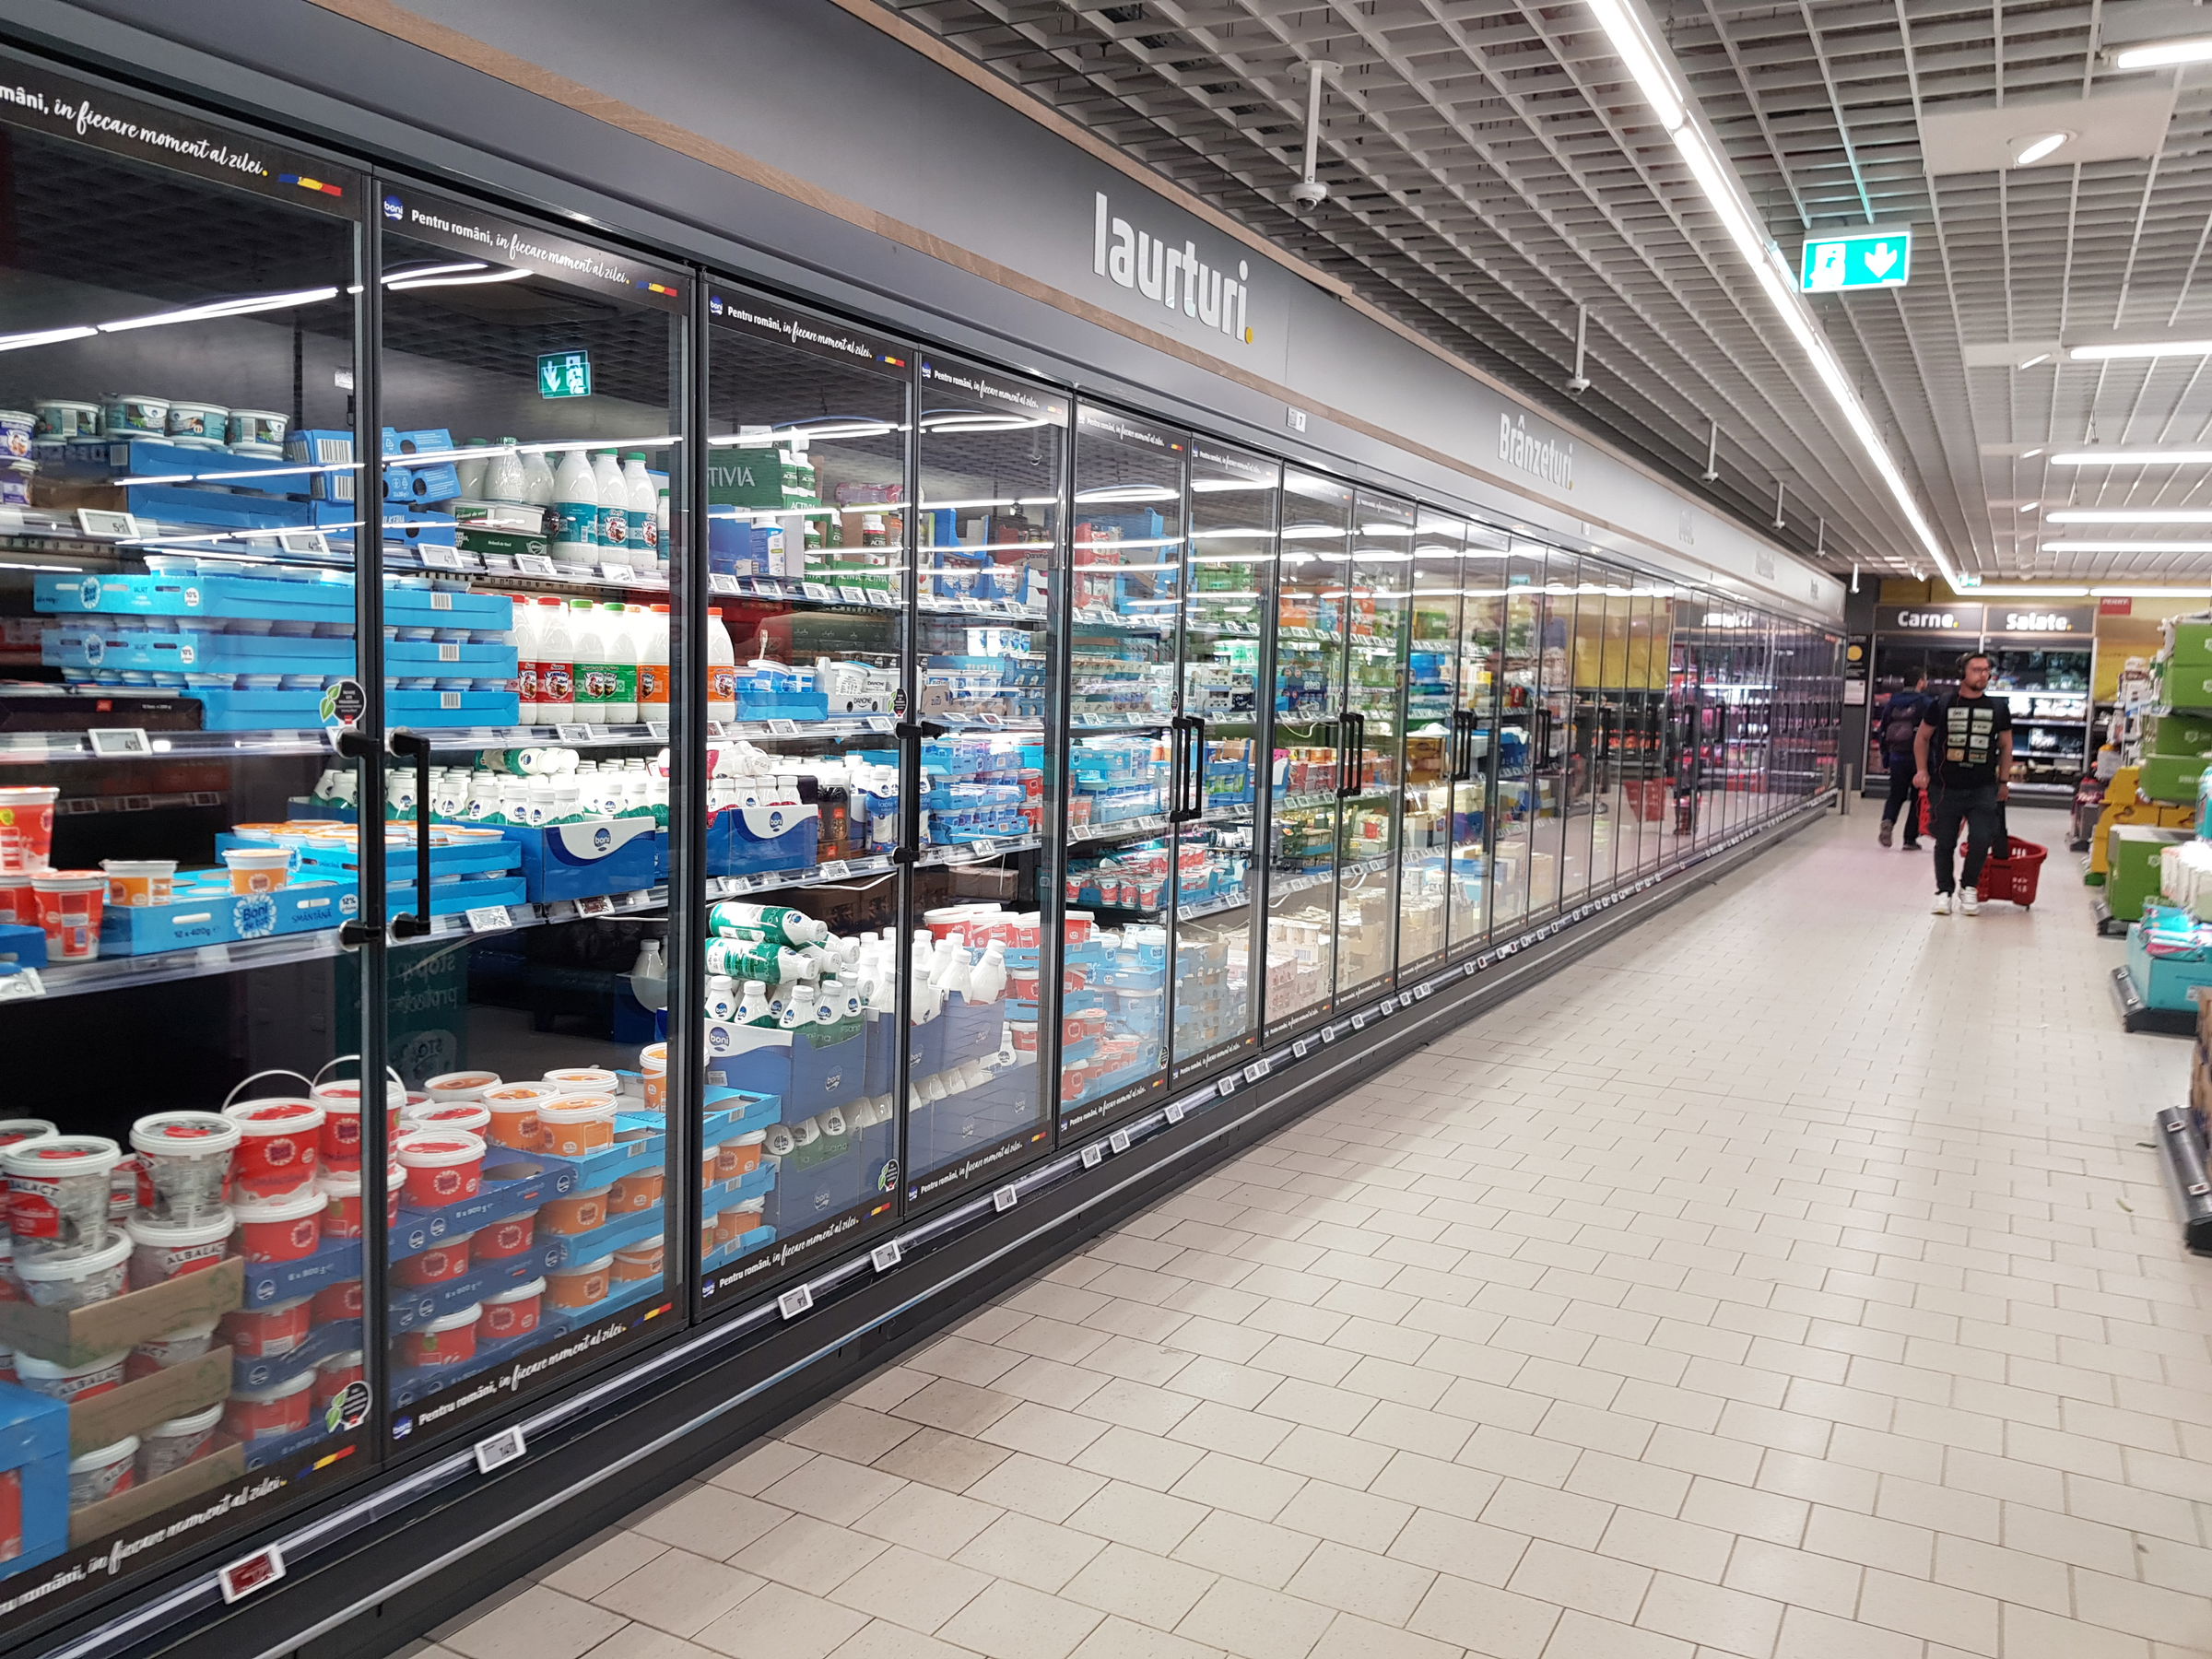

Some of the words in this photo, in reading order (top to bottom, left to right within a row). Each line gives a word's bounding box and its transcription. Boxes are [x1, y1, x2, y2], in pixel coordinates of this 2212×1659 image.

[76, 100, 138, 135] fiecare
[139, 127, 210, 159] moment
[209, 146, 229, 165] al
[383, 200, 403, 215] boni
[411, 209, 450, 231] Pentru
[451, 223, 494, 246] români,
[509, 233, 547, 260] fiecare
[547, 251, 593, 273] moment
[593, 262, 604, 276] al
[727, 306, 753, 323] Pentru
[753, 314, 782, 333] români,
[708, 466, 755, 487] TIVIA
[594, 835, 610, 845] boni
[341, 897, 356, 905] 12%
[243, 903, 268, 921] Boni
[709, 1032, 729, 1047] boni
[719, 1271, 744, 1288] Pentru
[744, 1256, 772, 1277] români,
[418, 1400, 456, 1426] Pentru
[456, 1381, 498, 1408] români,
